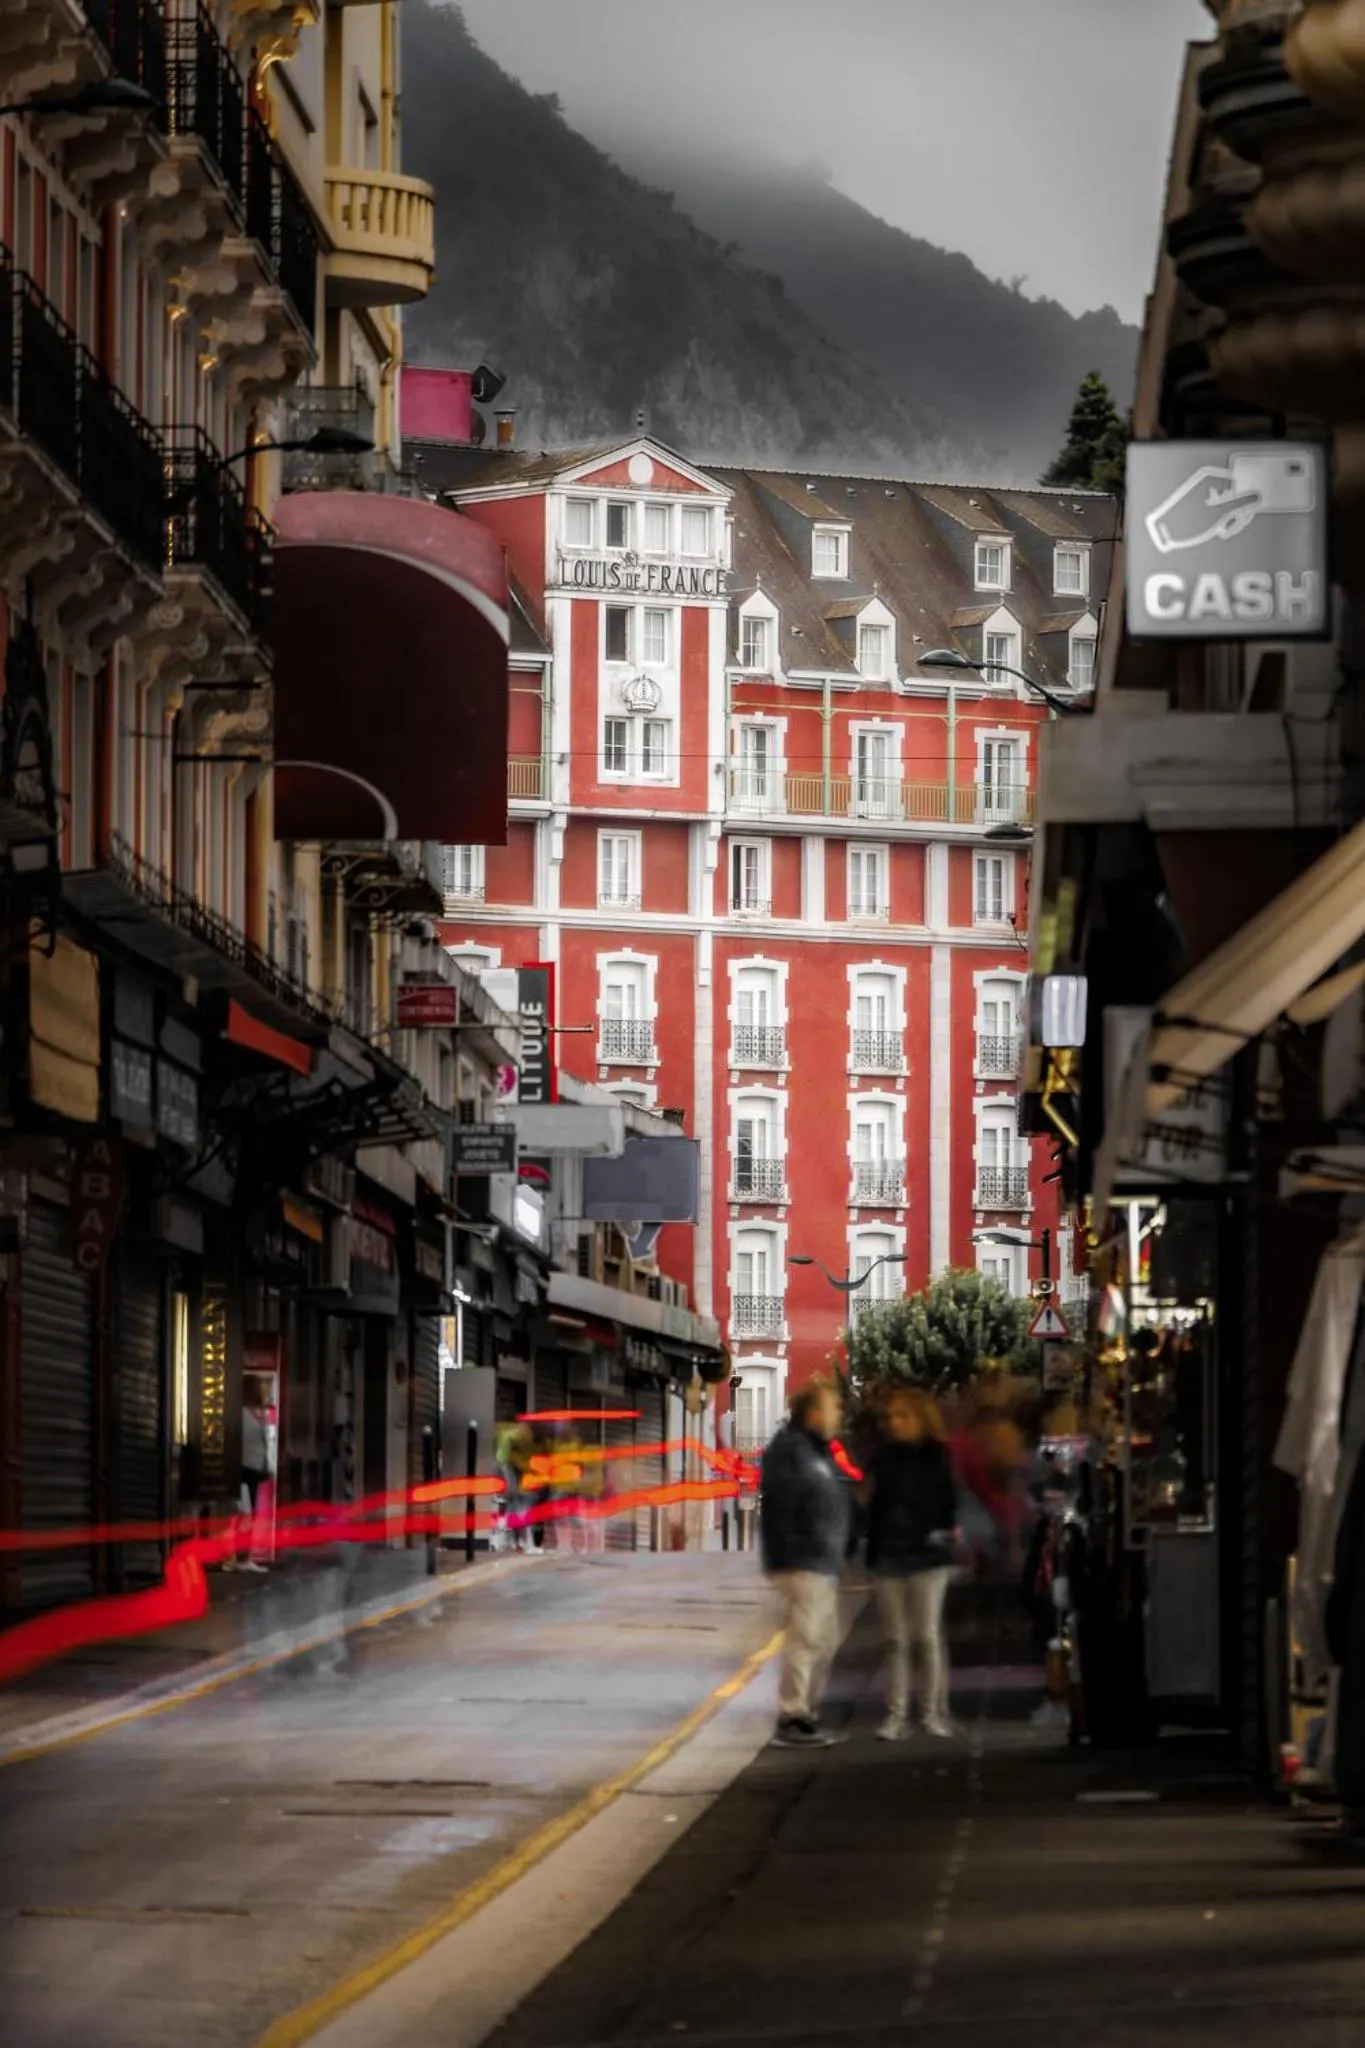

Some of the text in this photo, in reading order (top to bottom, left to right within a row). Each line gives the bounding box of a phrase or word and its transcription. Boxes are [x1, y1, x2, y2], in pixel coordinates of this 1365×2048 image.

[561, 559, 726, 594] LOUIS DE FRANCE
[1144, 571, 1318, 620] CASH
